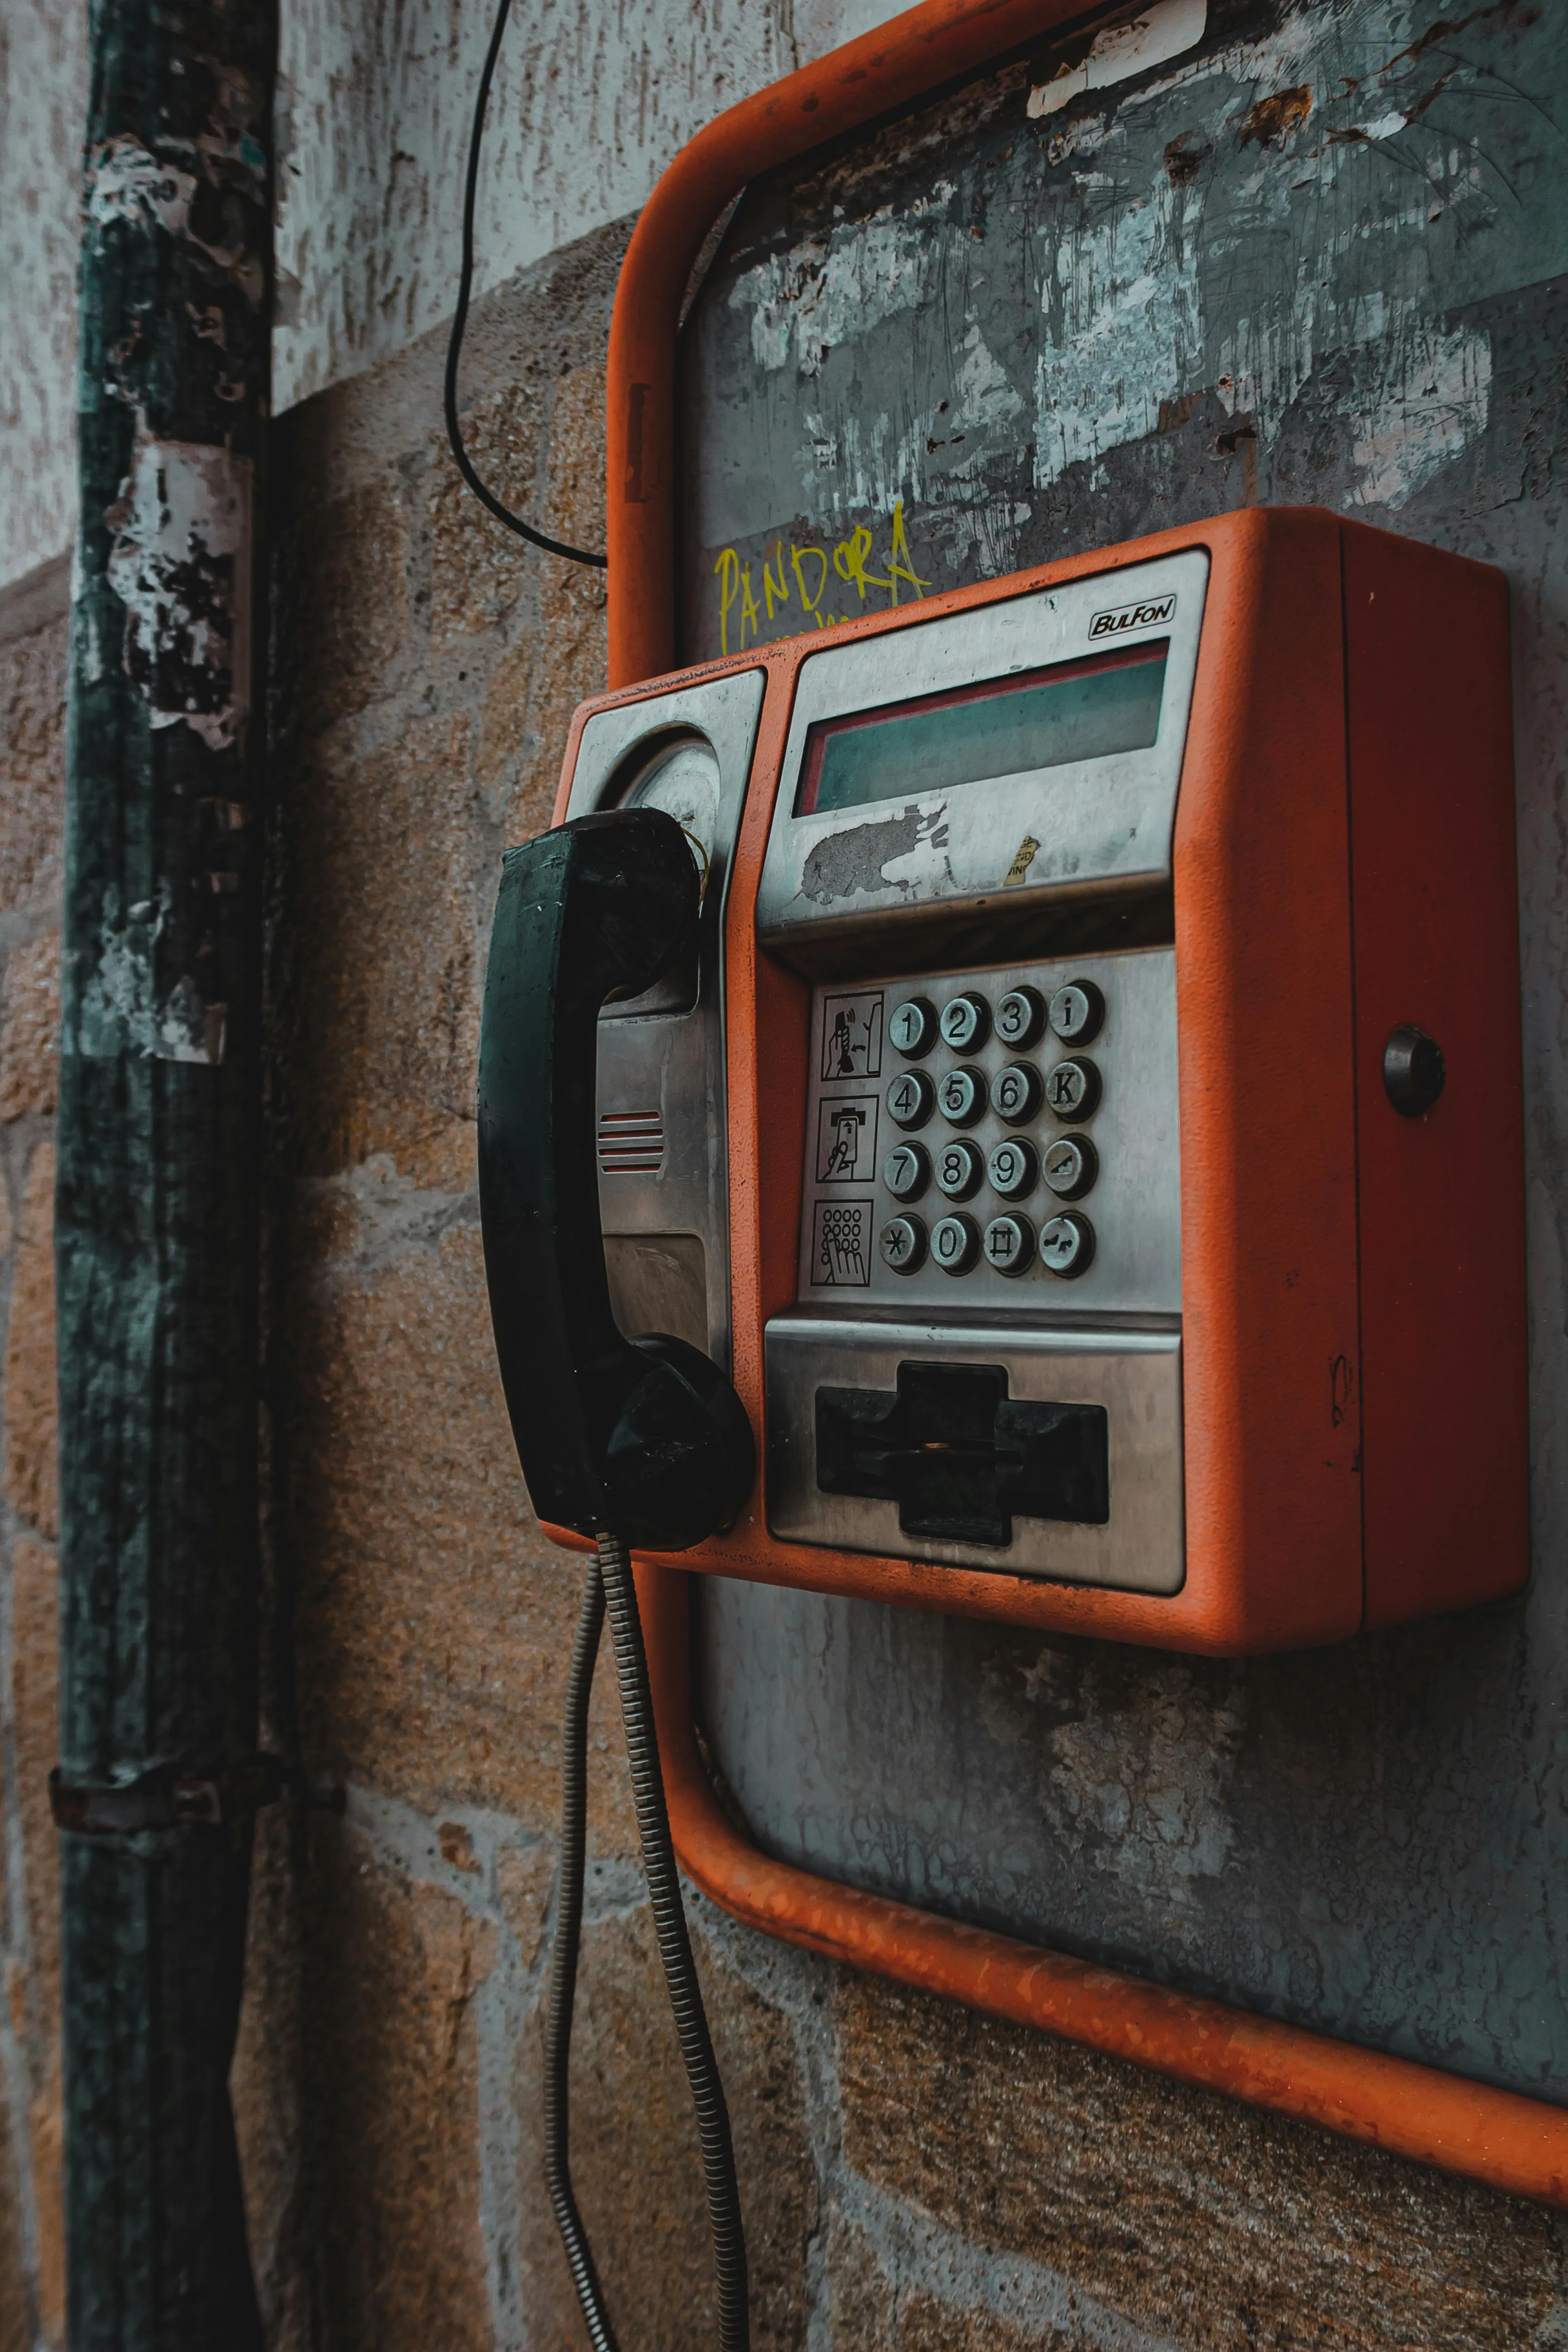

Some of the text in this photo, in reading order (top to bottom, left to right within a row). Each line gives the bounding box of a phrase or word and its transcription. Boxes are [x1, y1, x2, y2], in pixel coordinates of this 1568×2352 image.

[715, 501, 933, 656] PANDORA
[902, 1013, 911, 1042] 1
[949, 1007, 966, 1038] 2
[1002, 1002, 1021, 1034] 3
[894, 1073, 1075, 1114] 4 5 6 K
[892, 1151, 1015, 1185] 7 8 9
